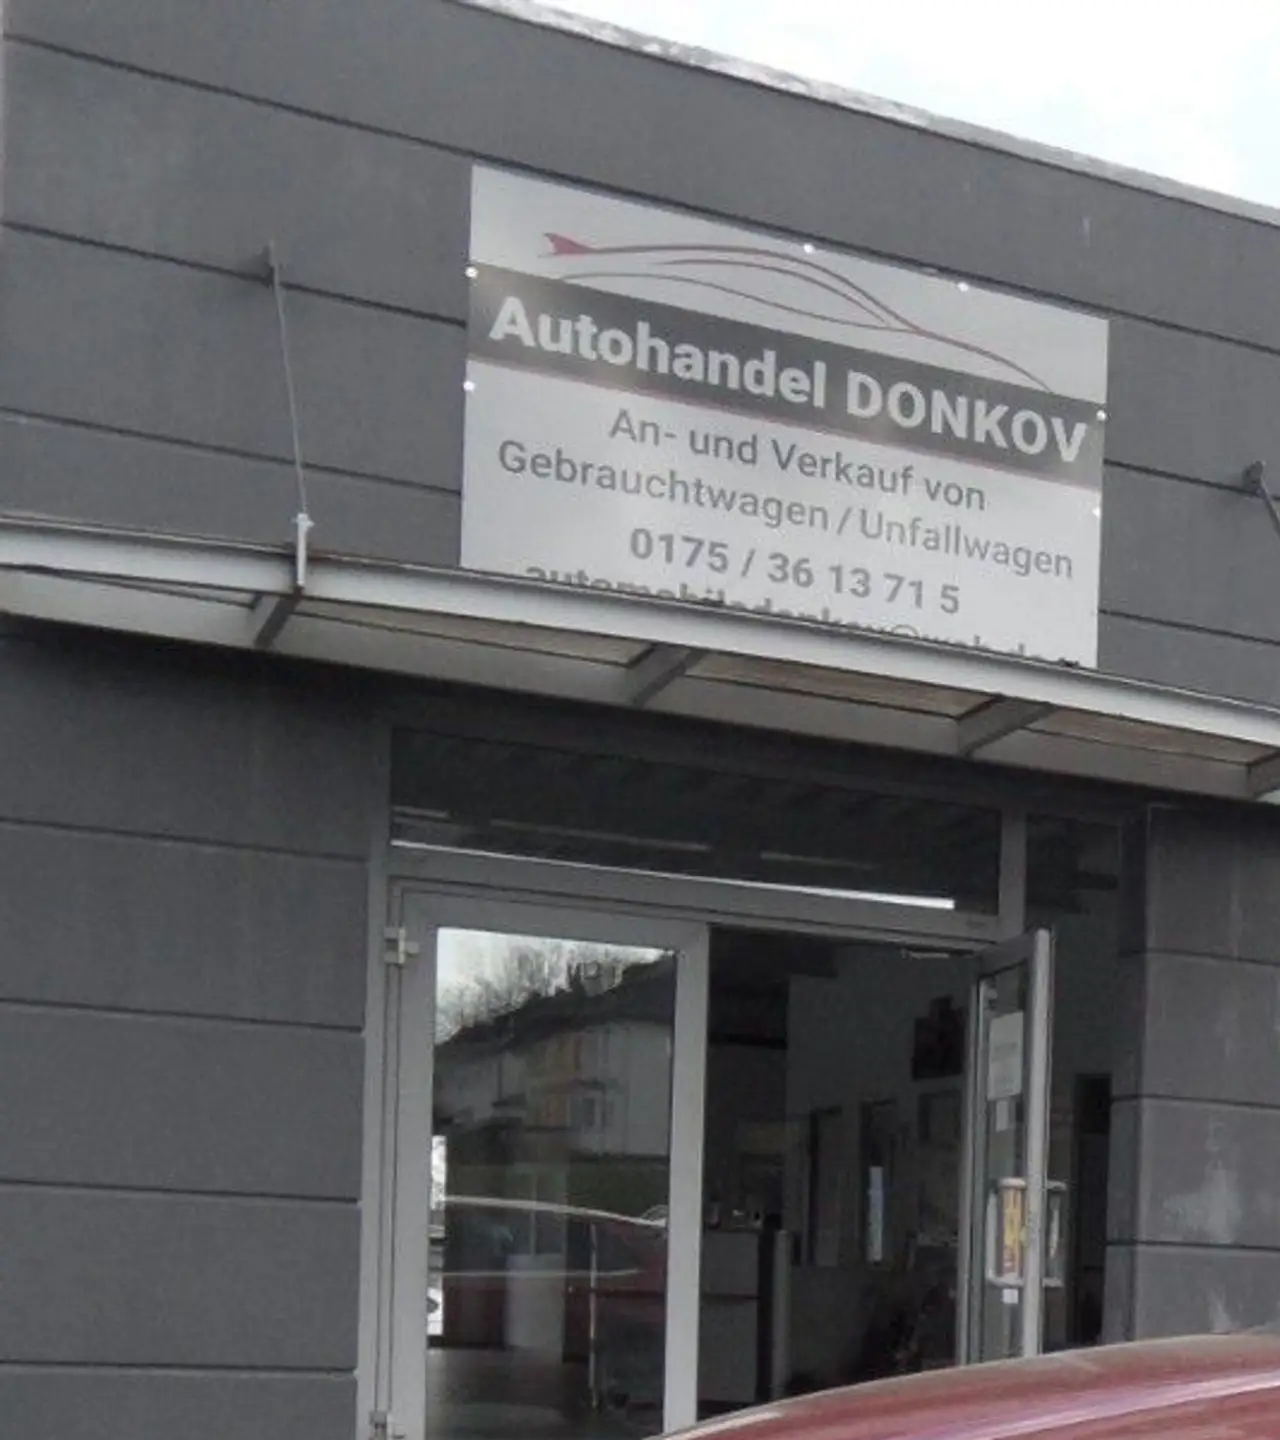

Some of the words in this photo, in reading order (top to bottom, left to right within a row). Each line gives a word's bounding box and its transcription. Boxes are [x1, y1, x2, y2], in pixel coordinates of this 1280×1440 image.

[489, 296, 827, 409] Autohandel
[846, 370, 1088, 462] DONKOV
[608, 408, 677, 446] An-
[689, 428, 758, 465] und
[771, 438, 914, 495] Verkauf
[924, 478, 986, 510] von
[629, 527, 729, 573] 0175
